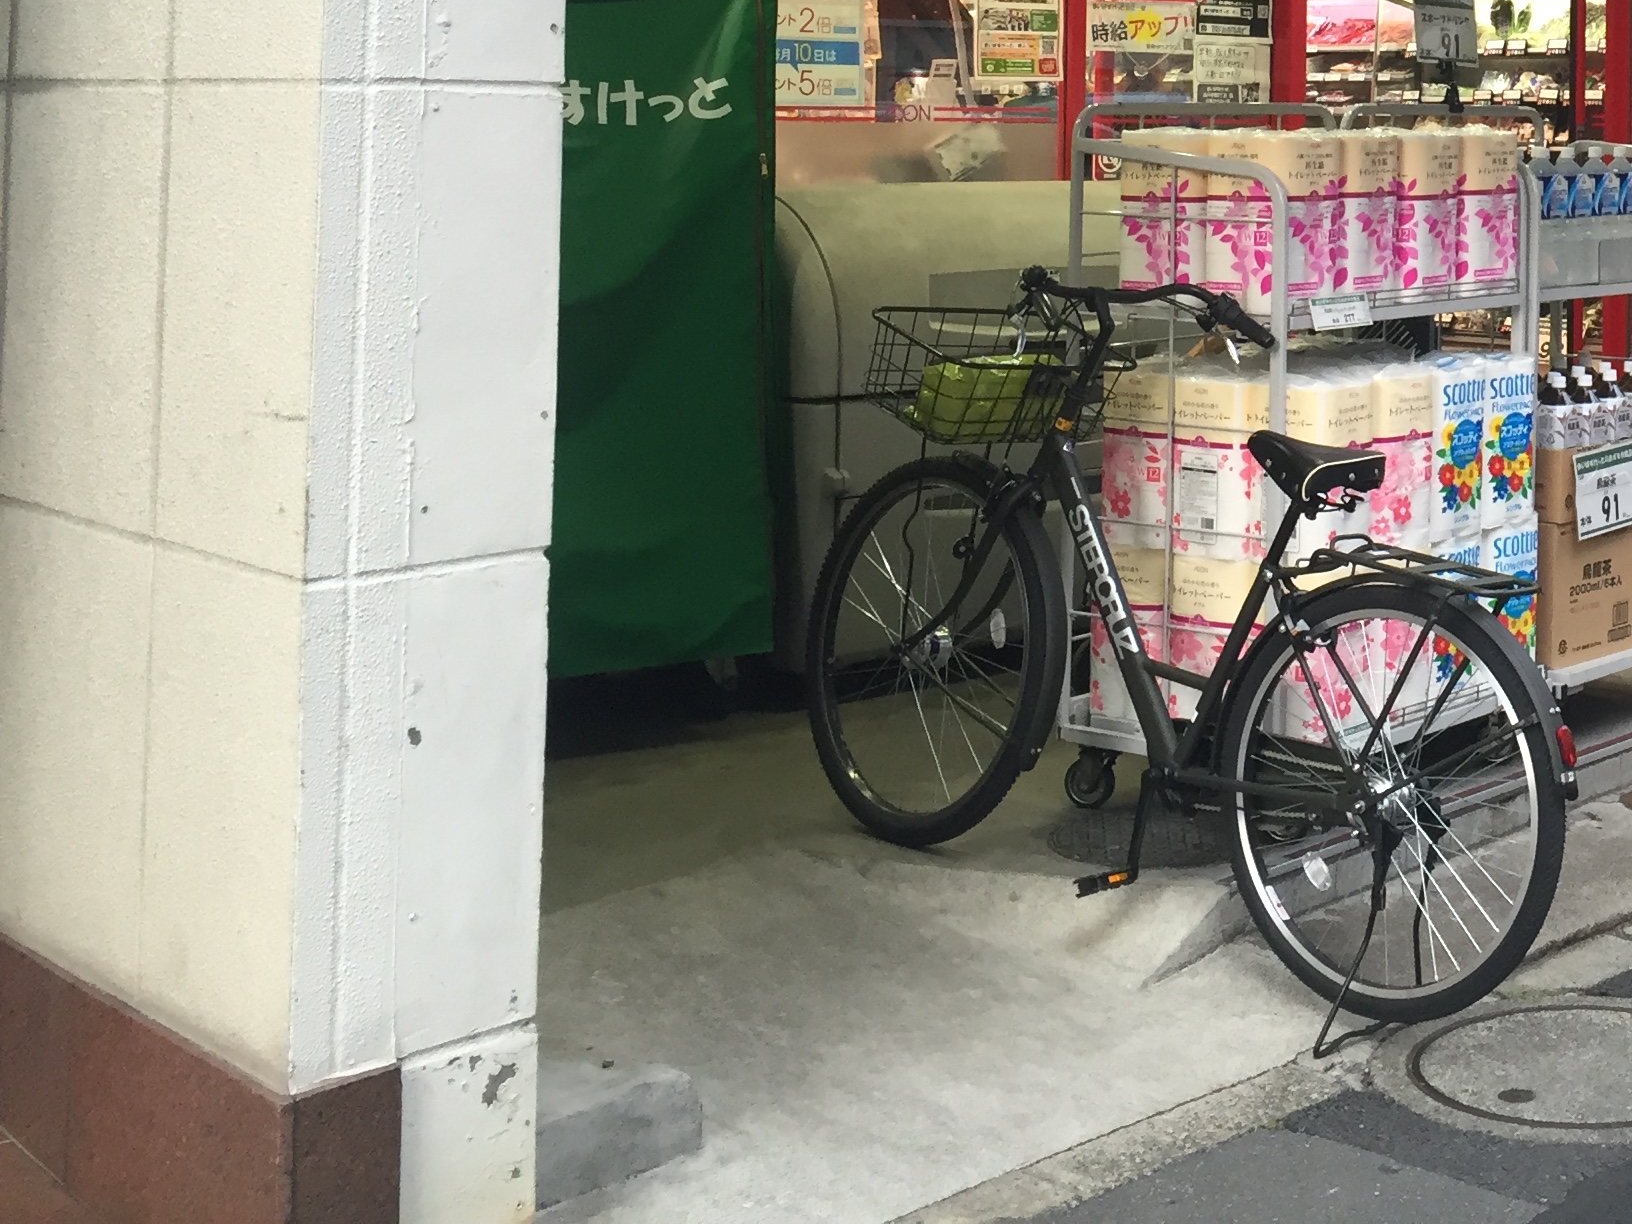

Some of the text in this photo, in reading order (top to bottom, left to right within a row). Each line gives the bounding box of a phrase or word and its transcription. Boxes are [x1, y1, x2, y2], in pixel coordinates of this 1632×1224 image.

[1441, 32, 1460, 57] 91
[1176, 410, 1230, 421] イレットペーパー
[1601, 493, 1620, 523] 91
[1175, 586, 1231, 599] イレットペーパー
